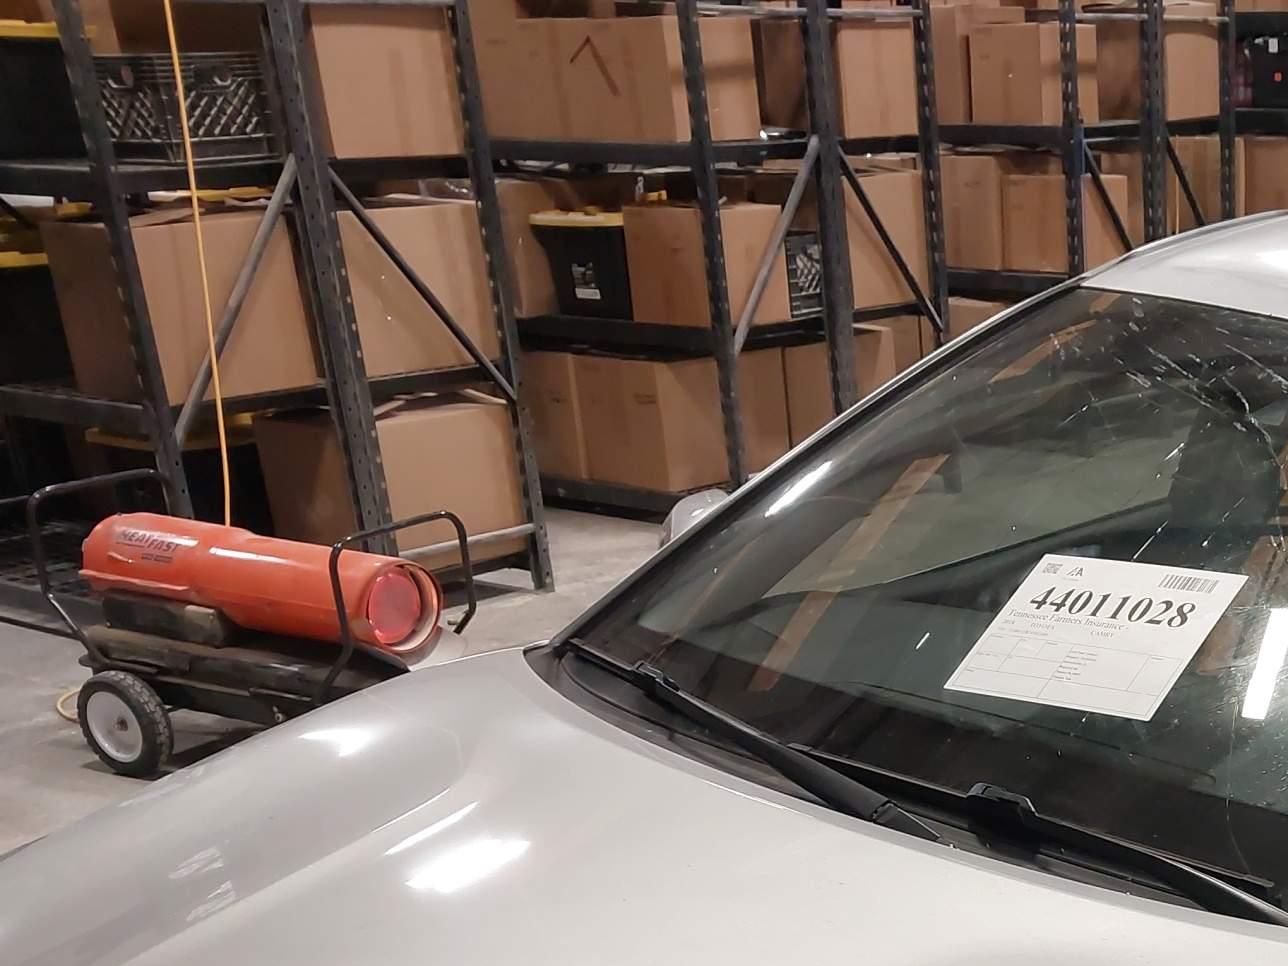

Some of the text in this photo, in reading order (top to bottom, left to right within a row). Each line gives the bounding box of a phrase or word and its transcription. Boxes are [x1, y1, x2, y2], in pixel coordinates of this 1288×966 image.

[1007, 609, 1049, 621] Tennessee
[1048, 614, 1083, 625] Farmers
[1084, 618, 1125, 631] Insurance
[1029, 586, 1196, 628] 44011028
